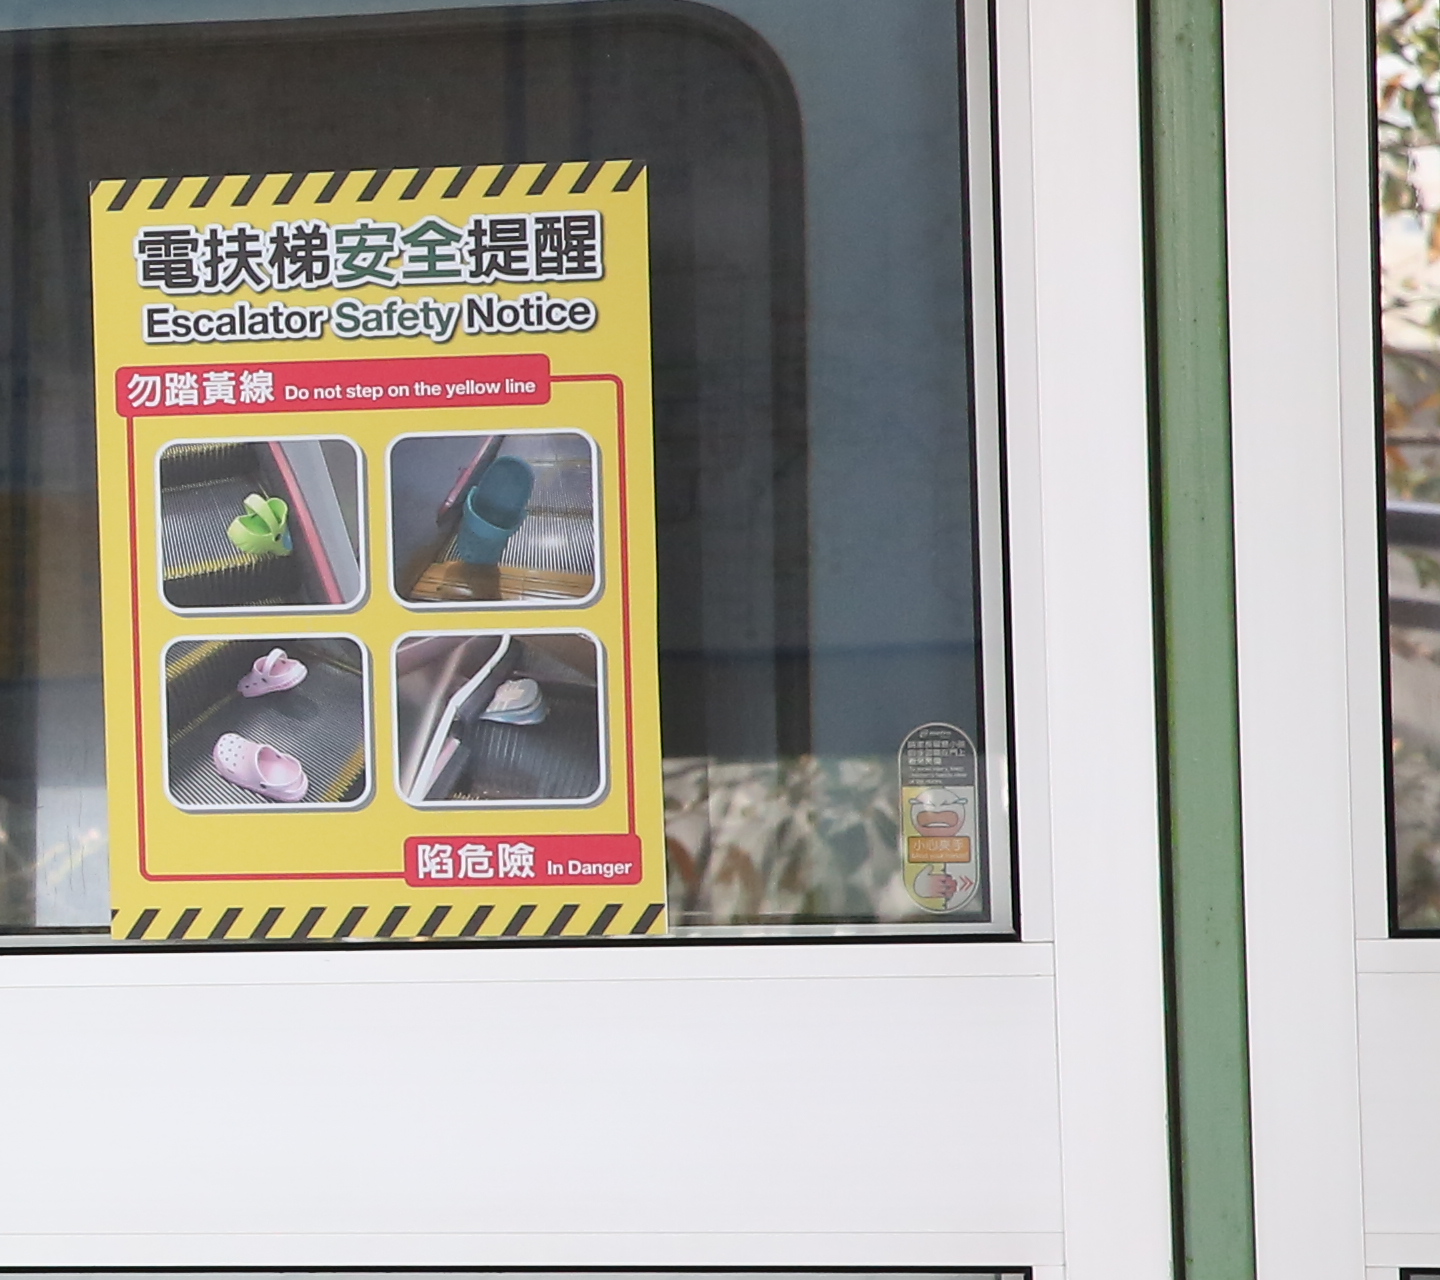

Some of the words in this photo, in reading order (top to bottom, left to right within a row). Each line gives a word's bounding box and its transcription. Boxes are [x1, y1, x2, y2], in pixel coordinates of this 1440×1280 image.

[136, 213, 601, 290] 電扶梯安全提醒
[146, 305, 324, 339] Escalator
[334, 300, 456, 339] Safety
[466, 294, 592, 331] Notice
[126, 370, 275, 407] 勿踏黃線
[284, 385, 308, 400] Do
[314, 384, 342, 400] not
[346, 382, 384, 402] step
[387, 385, 409, 398] on
[413, 382, 440, 397] the
[445, 380, 499, 397] yellow
[504, 378, 536, 394] line
[417, 842, 535, 880] 陷危險
[547, 860, 563, 875] In
[568, 858, 632, 880] Danger
